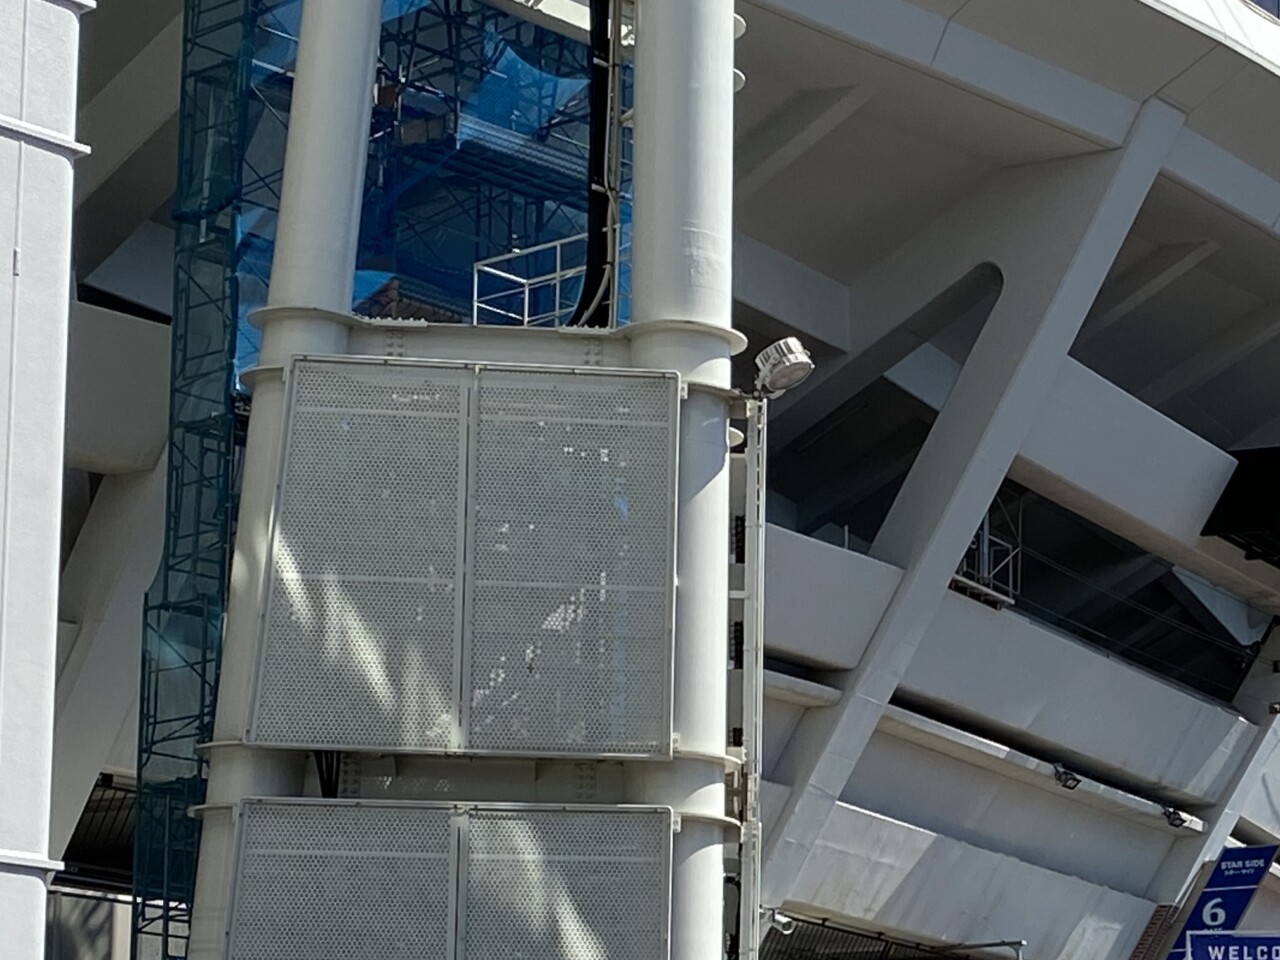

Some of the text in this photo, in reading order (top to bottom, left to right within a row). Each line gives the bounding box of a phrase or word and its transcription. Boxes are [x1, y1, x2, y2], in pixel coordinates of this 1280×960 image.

[1221, 858, 1265, 870] STAR SIDE
[1202, 897, 1226, 926] 6
